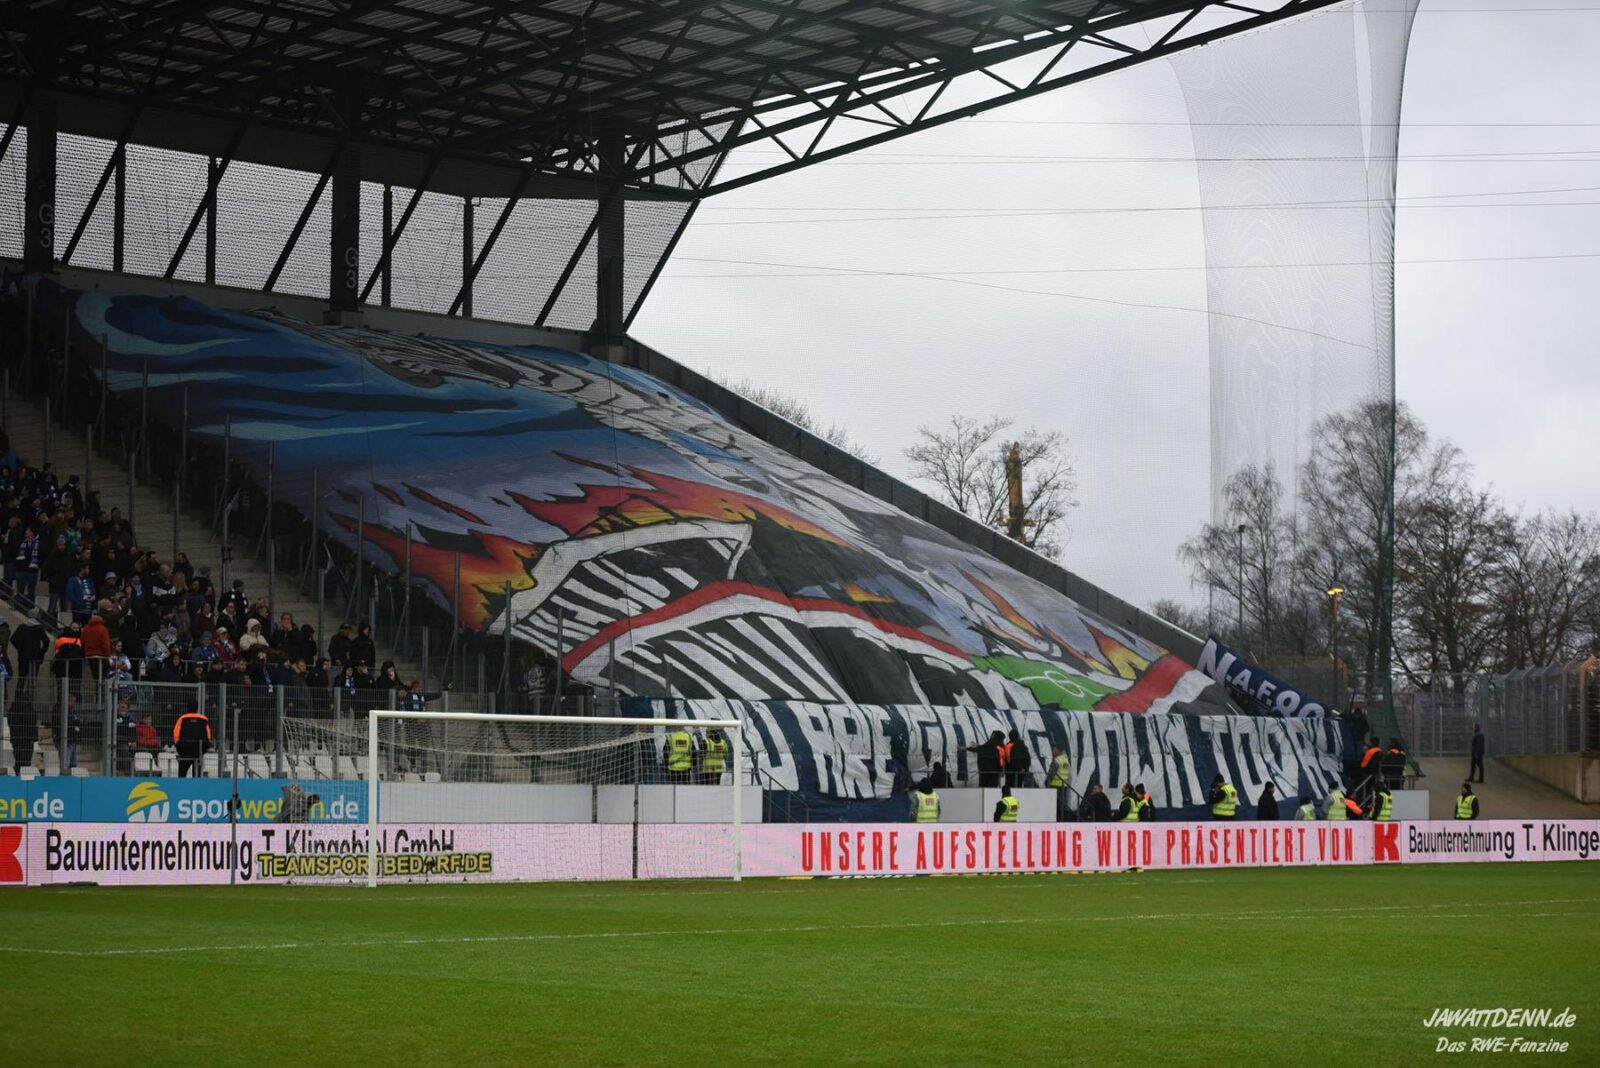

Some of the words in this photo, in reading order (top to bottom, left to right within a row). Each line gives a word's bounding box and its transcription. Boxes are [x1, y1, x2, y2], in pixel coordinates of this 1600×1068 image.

[786, 700, 896, 799] ARE
[1058, 711, 1206, 811] DOWN
[46, 829, 253, 881] Bauunternehmung
[802, 831, 898, 871] UNSERE
[916, 830, 1083, 870] AUFSTELLUNG
[1097, 830, 1151, 867] WIRD
[1166, 825, 1306, 865] PRÄSENTIERT
[1318, 827, 1353, 862] VON
[1409, 825, 1515, 859] Bauunternehmung
[1522, 823, 1536, 852] T.
